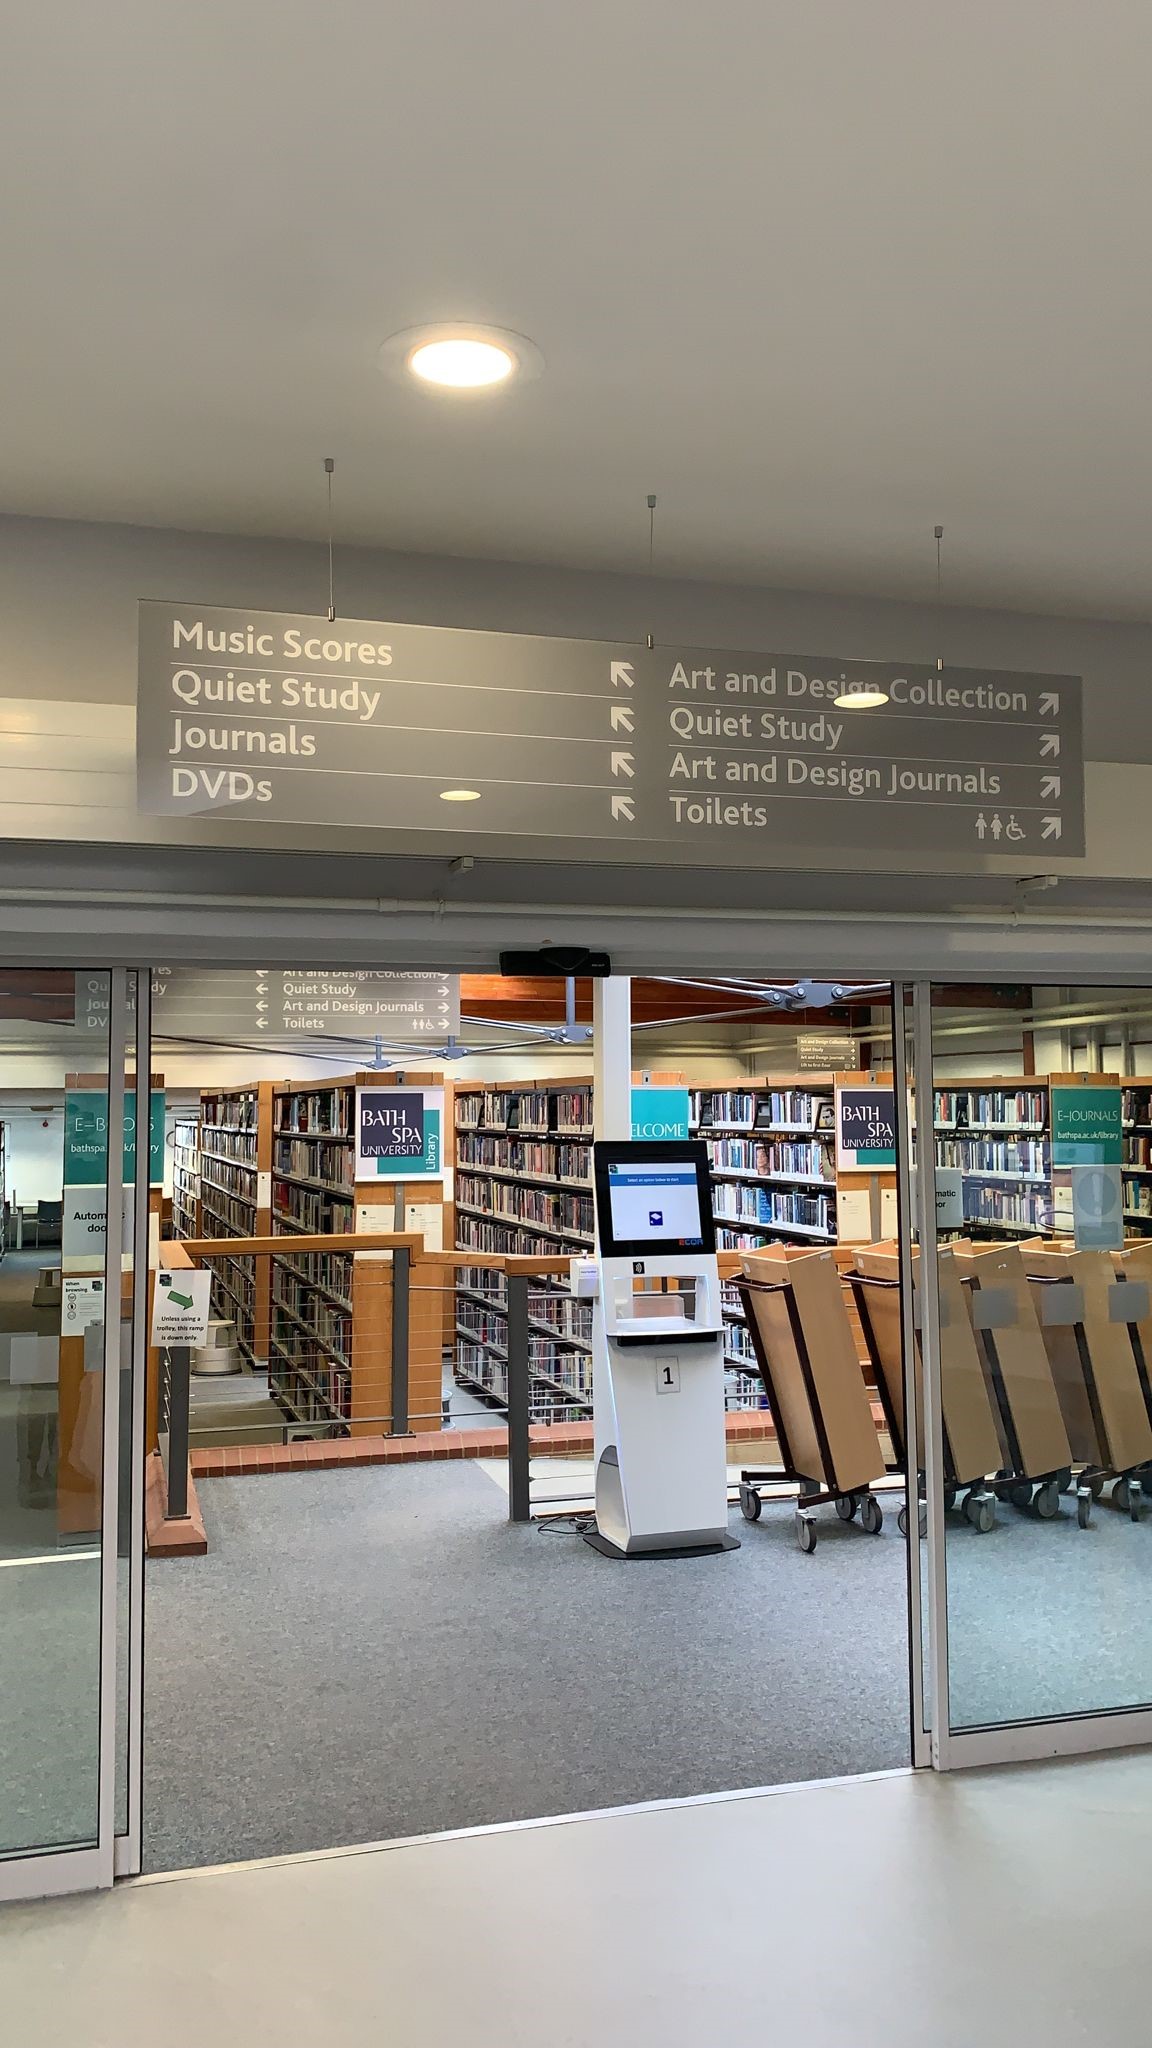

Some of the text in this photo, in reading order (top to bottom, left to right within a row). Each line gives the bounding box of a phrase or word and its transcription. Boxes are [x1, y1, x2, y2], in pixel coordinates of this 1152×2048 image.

[173, 620, 393, 666] Music Scores
[172, 670, 381, 721] Quiet Study
[668, 662, 716, 692] Art
[725, 667, 777, 696] and
[889, 678, 1027, 711] Collection
[169, 719, 317, 756] Journals
[669, 707, 844, 750] Quiet Study
[669, 752, 1001, 796] Art and Design Journals
[171, 768, 273, 802] DVDs
[669, 796, 768, 827] Toilets
[283, 983, 357, 997] Quiet Study
[283, 1000, 425, 1014] Art and Design Journals
[283, 1017, 325, 1029] Toilets
[362, 1109, 406, 1127] BATH
[842, 1106, 880, 1122] BATH
[1057, 1110, 1118, 1122] E-JOURNALS
[391, 1127, 423, 1144] SPA
[631, 1123, 685, 1137] ELCOME
[867, 1122, 894, 1138] SPA
[361, 1144, 423, 1156] UNIVERSITY
[426, 1133, 439, 1171] Library
[843, 1138, 894, 1149] UNIVERSITY
[662, 1365, 675, 1385] 1
